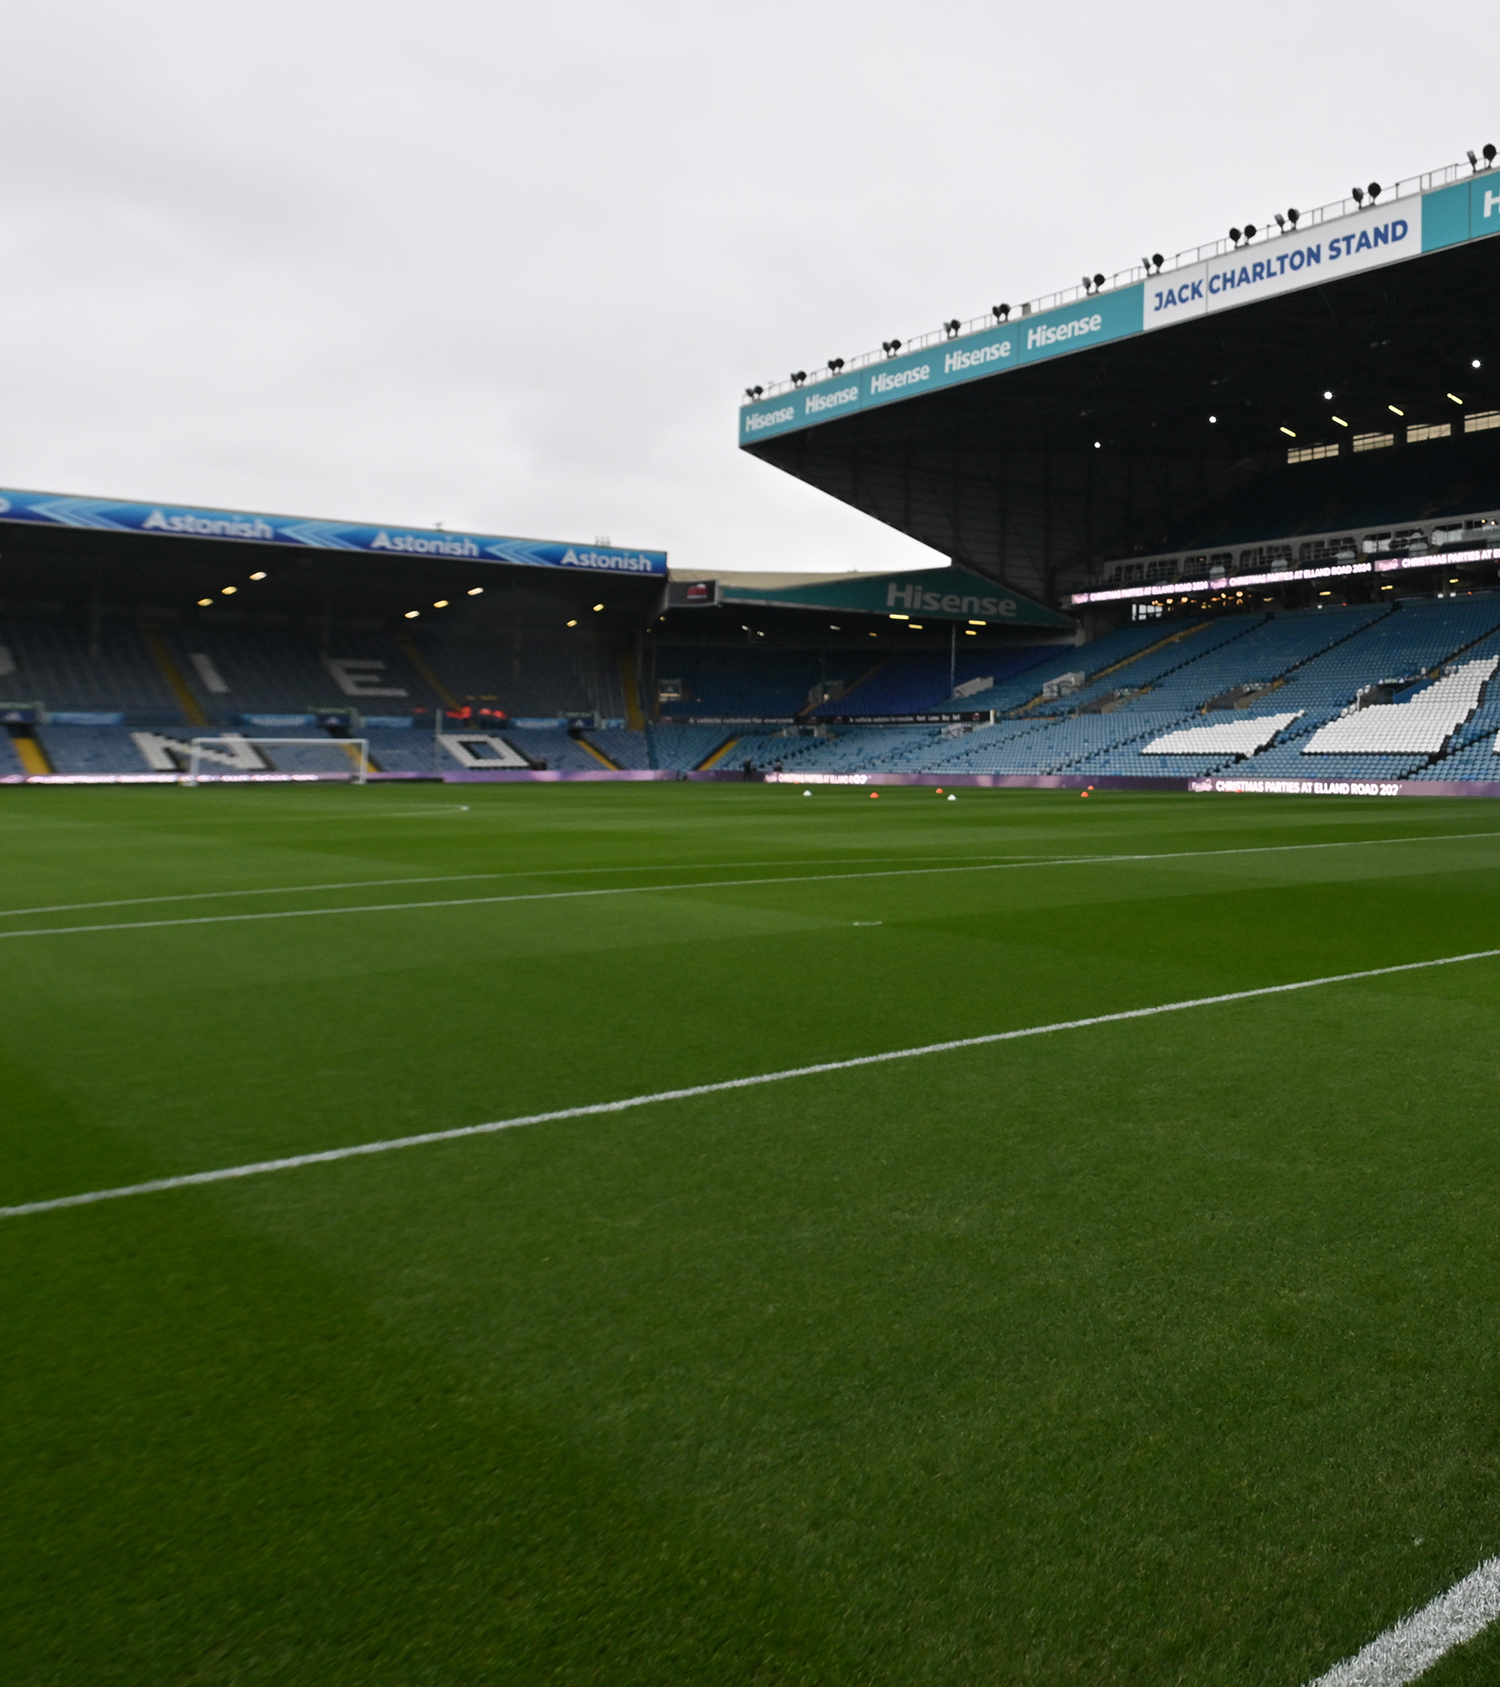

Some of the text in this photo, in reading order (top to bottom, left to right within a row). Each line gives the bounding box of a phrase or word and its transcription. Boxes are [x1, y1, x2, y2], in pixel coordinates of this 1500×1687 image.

[1154, 219, 1408, 311] JACK CHARLTON STAND
[1027, 313, 1101, 350] Hisense
[944, 340, 1011, 373] Hisense
[870, 364, 930, 394] Hisense
[805, 385, 858, 414] Hisense
[745, 405, 794, 432] Hisense
[142, 509, 275, 540] Astonish
[369, 530, 479, 557] Astonish
[560, 549, 651, 572] Astonish
[886, 582, 1016, 617] Hisense
[1215, 780, 1264, 793] CHRISTMAS
[1265, 781, 1300, 793] PARTIES
[1301, 782, 1312, 793] AT
[1314, 782, 1349, 794] ELLAND
[1351, 783, 1379, 795] ROAD
[1379, 784, 1402, 796] 202
